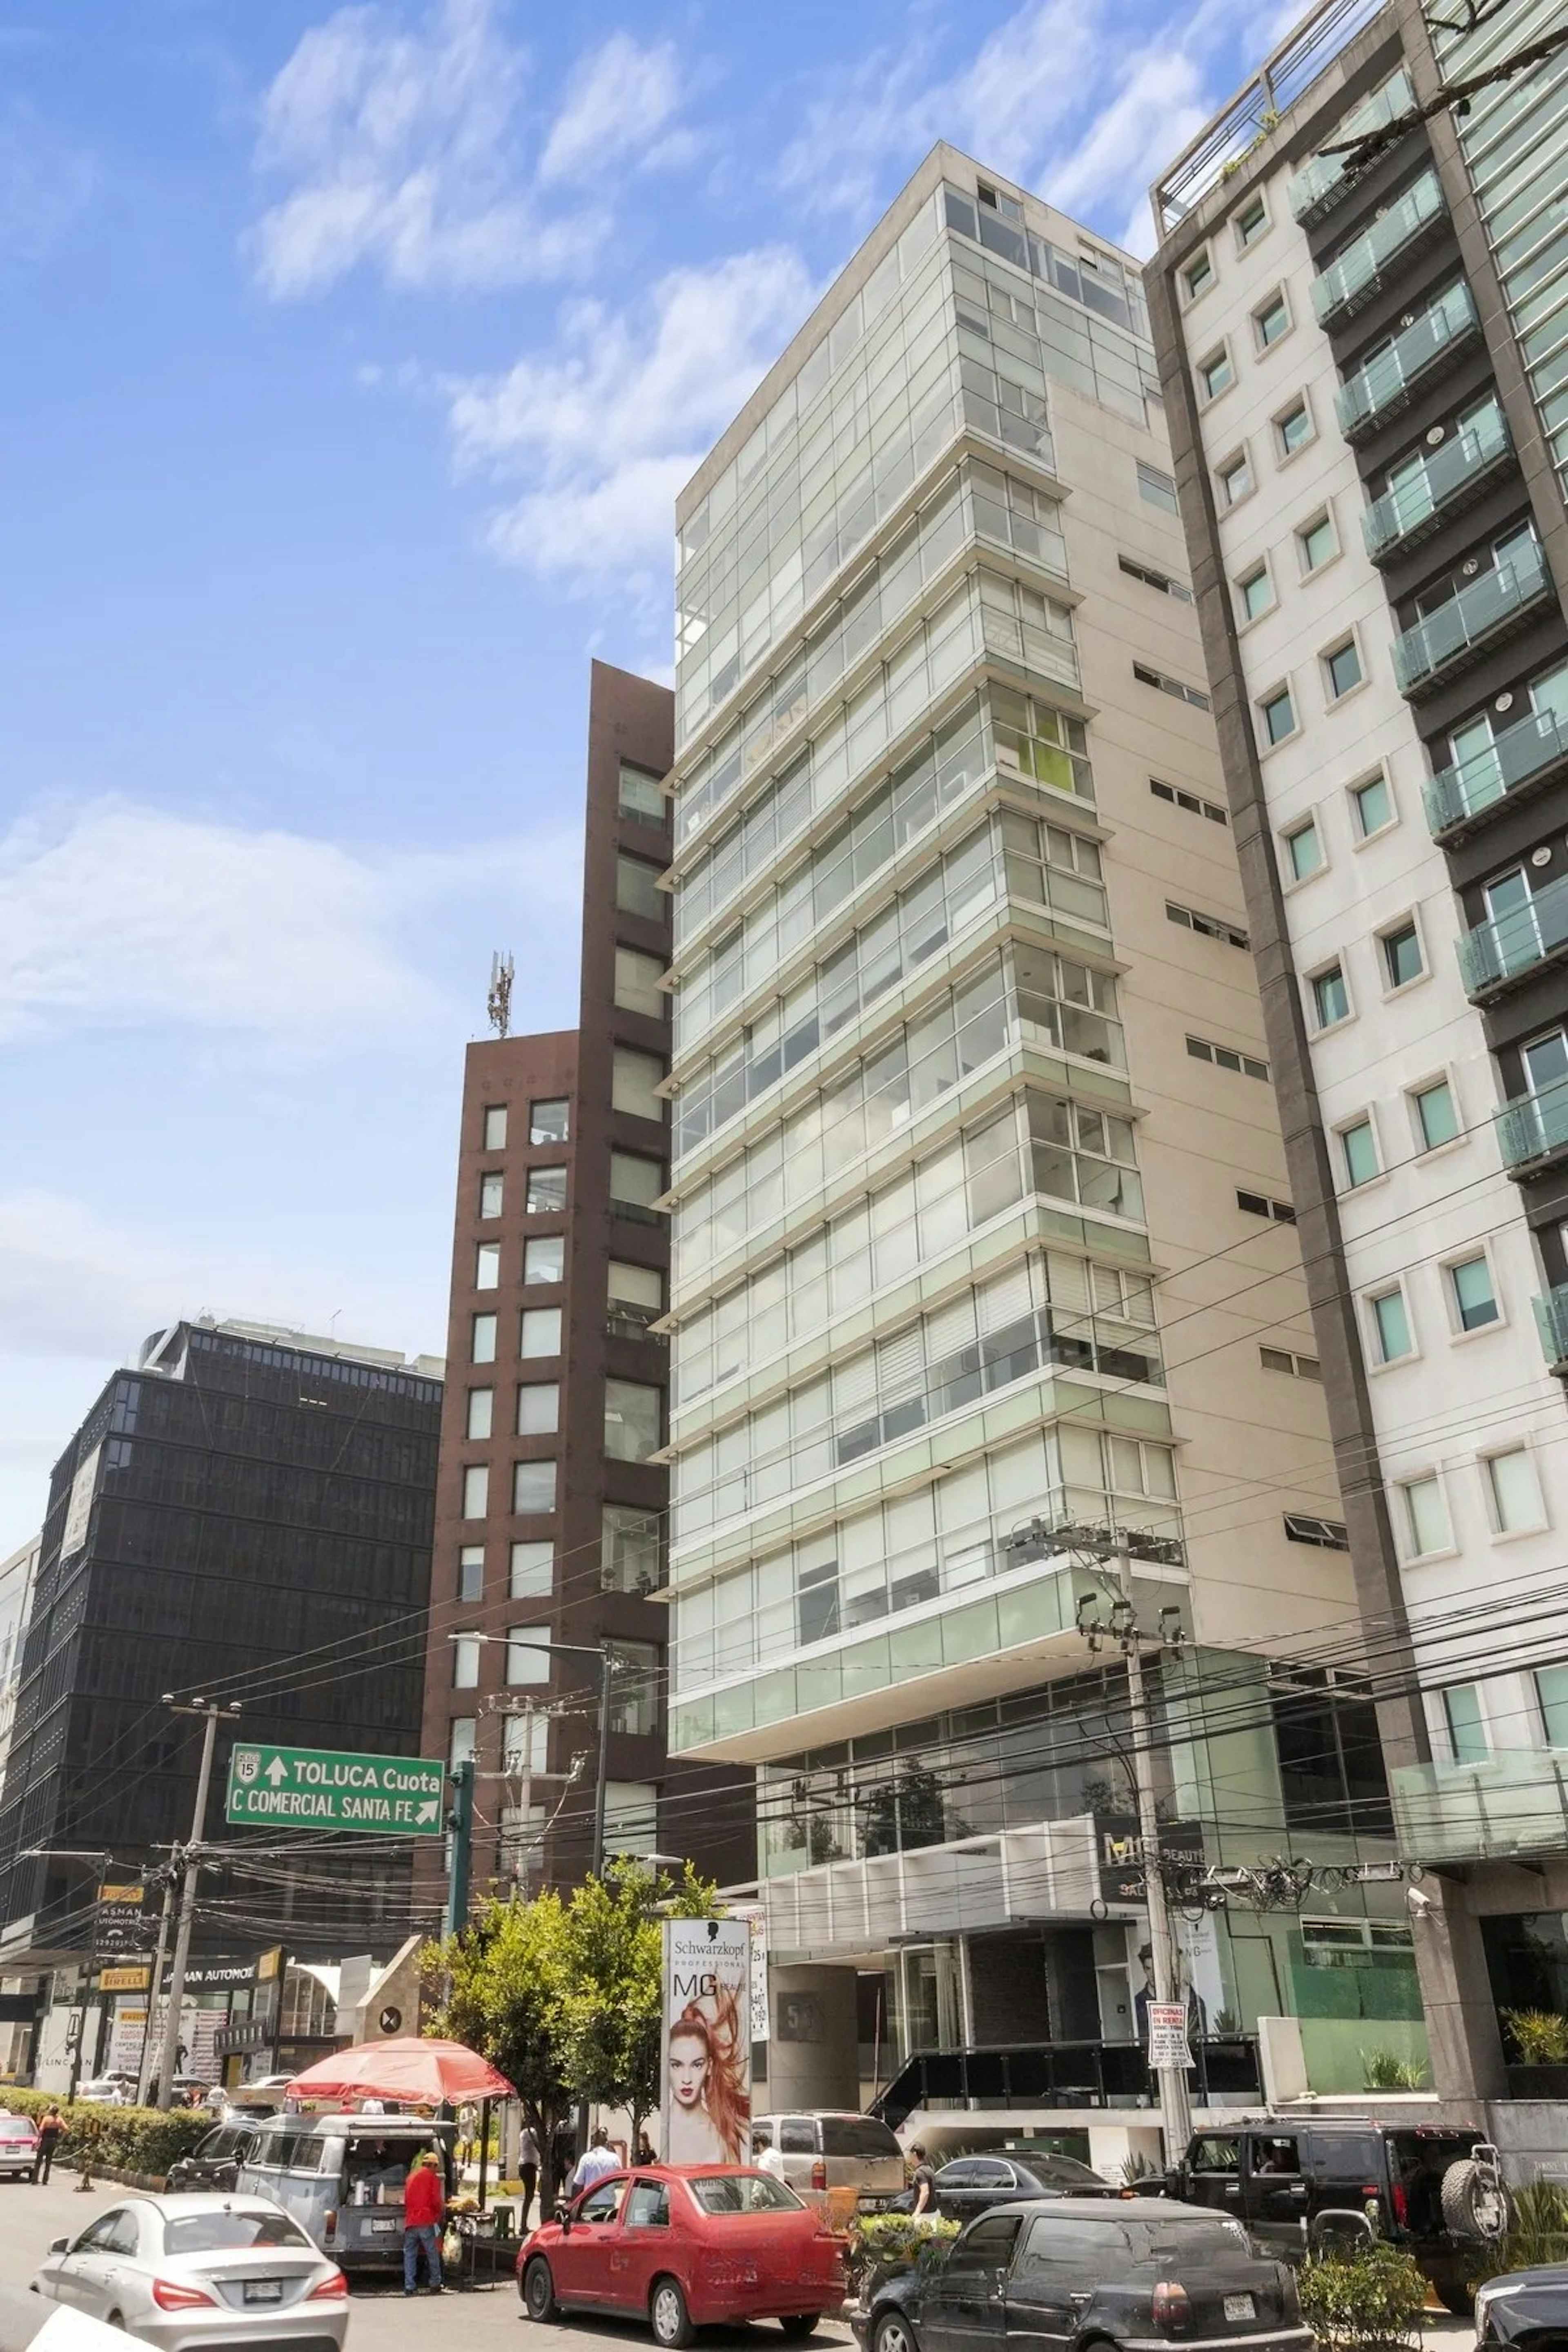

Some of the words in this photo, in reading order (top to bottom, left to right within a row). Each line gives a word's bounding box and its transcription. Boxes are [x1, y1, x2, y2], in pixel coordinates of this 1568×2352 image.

[242, 1764, 254, 1776] 15
[294, 1761, 378, 1788] TOLUCA
[383, 1768, 440, 1793] Cuota
[232, 1789, 243, 1811] C
[247, 1790, 336, 1817] COMERCIAL
[341, 1797, 391, 1820] SANTA
[395, 1801, 414, 1822] FE
[101, 1907, 142, 1917] ASMAN
[675, 1940, 745, 1960] Schwarzkopf
[674, 1974, 716, 1996] MG
